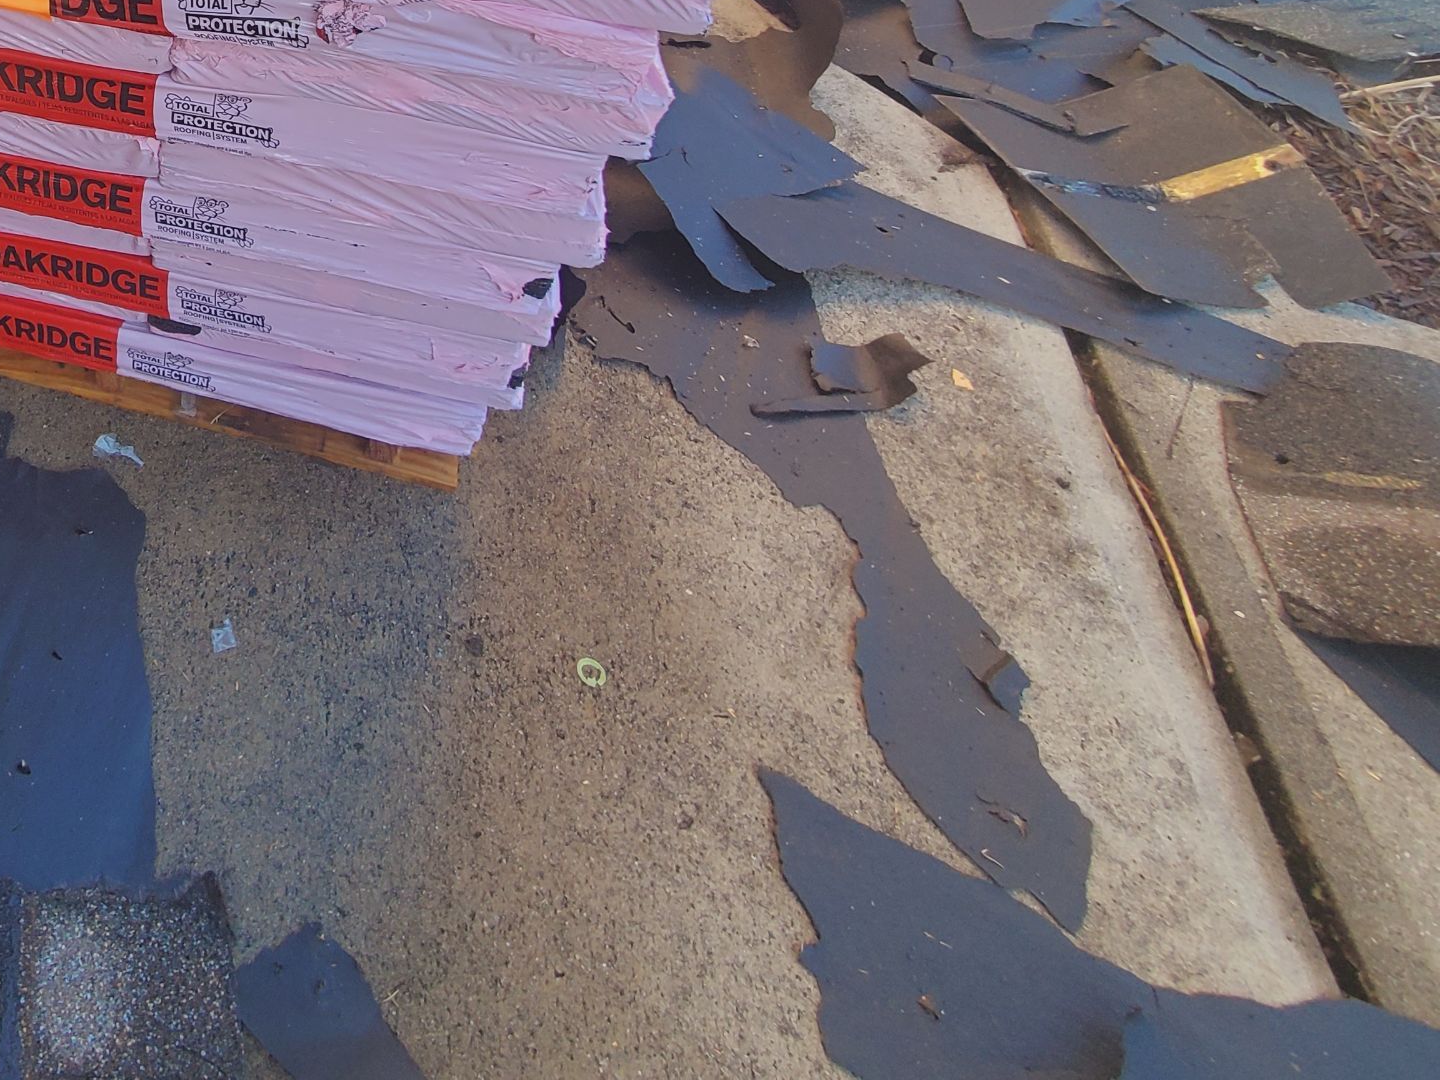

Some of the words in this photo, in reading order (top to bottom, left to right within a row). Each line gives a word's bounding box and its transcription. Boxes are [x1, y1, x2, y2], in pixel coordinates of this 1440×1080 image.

[189, 16, 299, 39] PROTECTION
[175, 101, 210, 114] TOTAL
[173, 112, 270, 140] PROTECTION
[174, 125, 212, 138] ROOFING
[216, 133, 248, 145] SYSTEM
[159, 203, 191, 216] TOTAL
[157, 212, 245, 240] PROTECTION
[158, 225, 192, 238] ROOFING
[195, 230, 225, 245] SYSTEM
[184, 291, 214, 304] TOTAL
[182, 300, 265, 327] PROTECTION
[183, 309, 216, 322] ROOFING
[136, 353, 161, 364] TOTAL
[133, 360, 209, 388] PROTECTION
